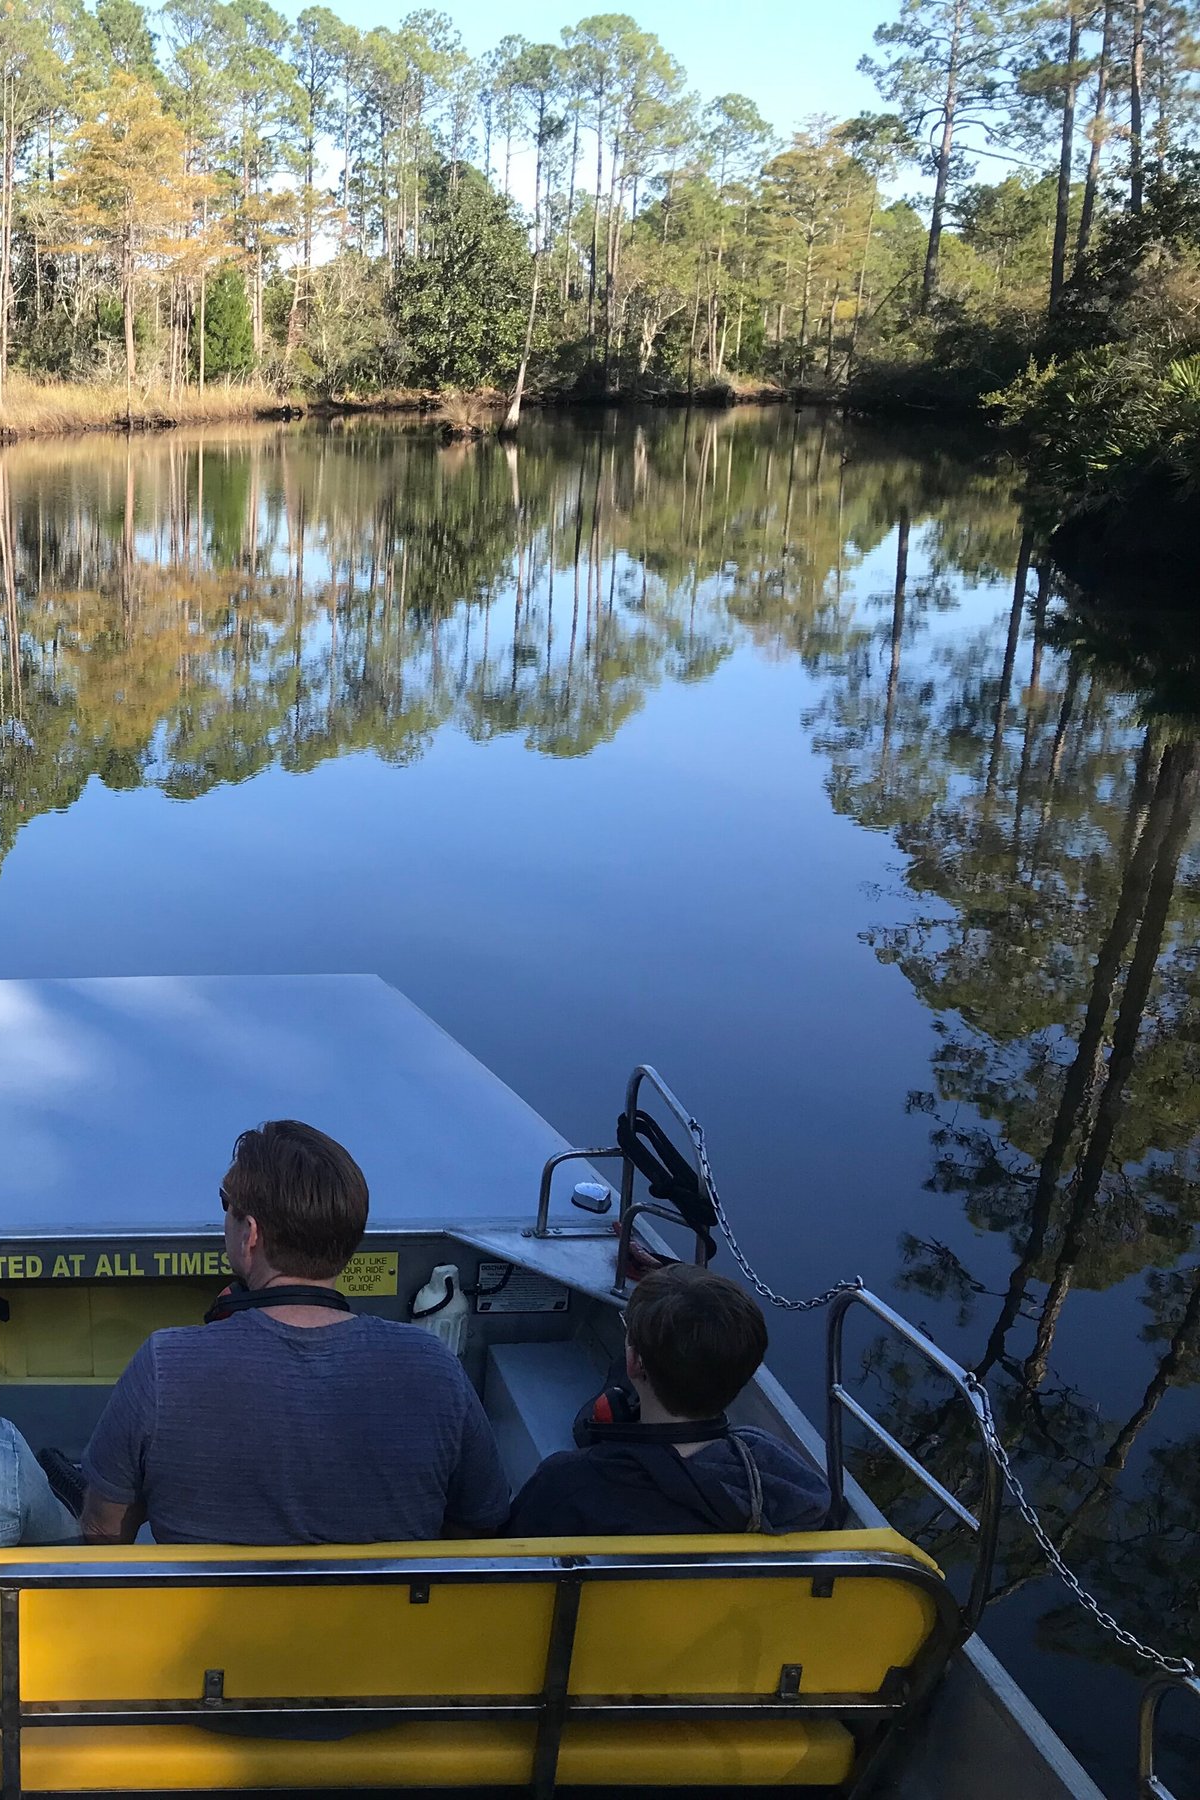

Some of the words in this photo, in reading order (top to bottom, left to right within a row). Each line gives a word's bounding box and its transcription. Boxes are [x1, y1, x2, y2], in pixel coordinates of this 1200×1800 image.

[52, 1254, 86, 1277] AT
[94, 1253, 145, 1277] ALL
[153, 1252, 233, 1275] TIMES
[370, 1257, 388, 1265] LIKE
[341, 1266, 362, 1274] OUR
[366, 1266, 384, 1274] RIDE
[342, 1275, 354, 1283] TIP
[358, 1275, 381, 1283] YOUR
[348, 1283, 374, 1291] GUIDE
